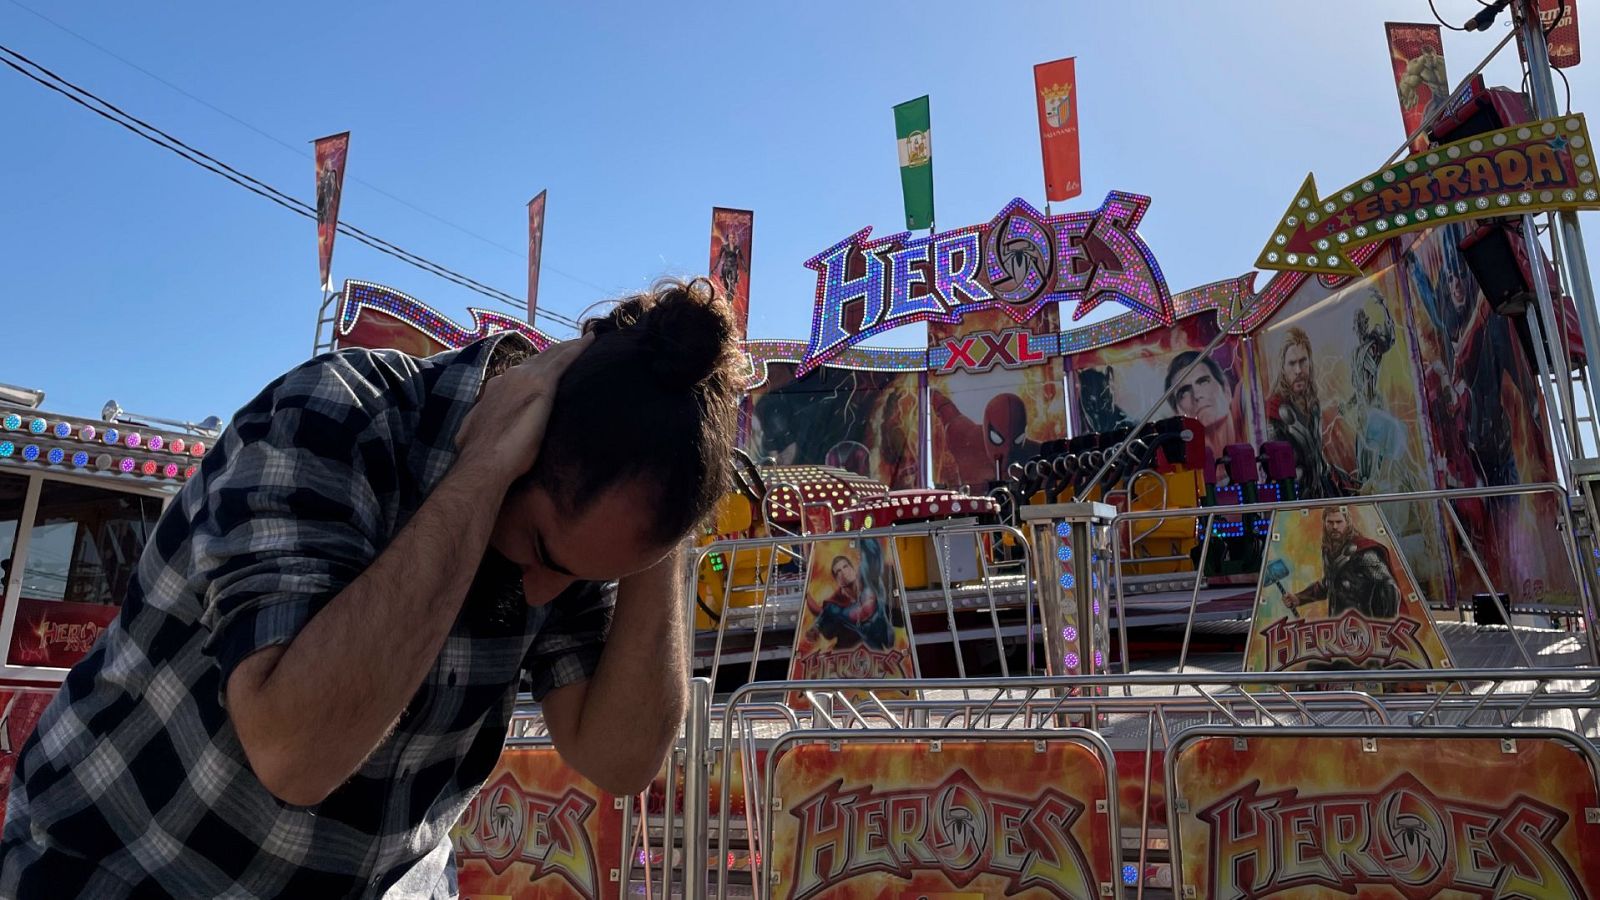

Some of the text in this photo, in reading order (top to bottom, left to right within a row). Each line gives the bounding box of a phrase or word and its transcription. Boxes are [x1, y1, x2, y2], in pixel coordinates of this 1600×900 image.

[1354, 143, 1565, 223] ENTRADA
[798, 192, 1173, 372] HEROES
[943, 331, 1045, 371] XXL
[39, 620, 104, 649] HERO
[802, 645, 907, 682] HEROES
[1264, 614, 1432, 671] HEROES
[448, 784, 598, 900] ROES
[792, 776, 1099, 900] HEROES
[1204, 784, 1594, 900] HEROES
